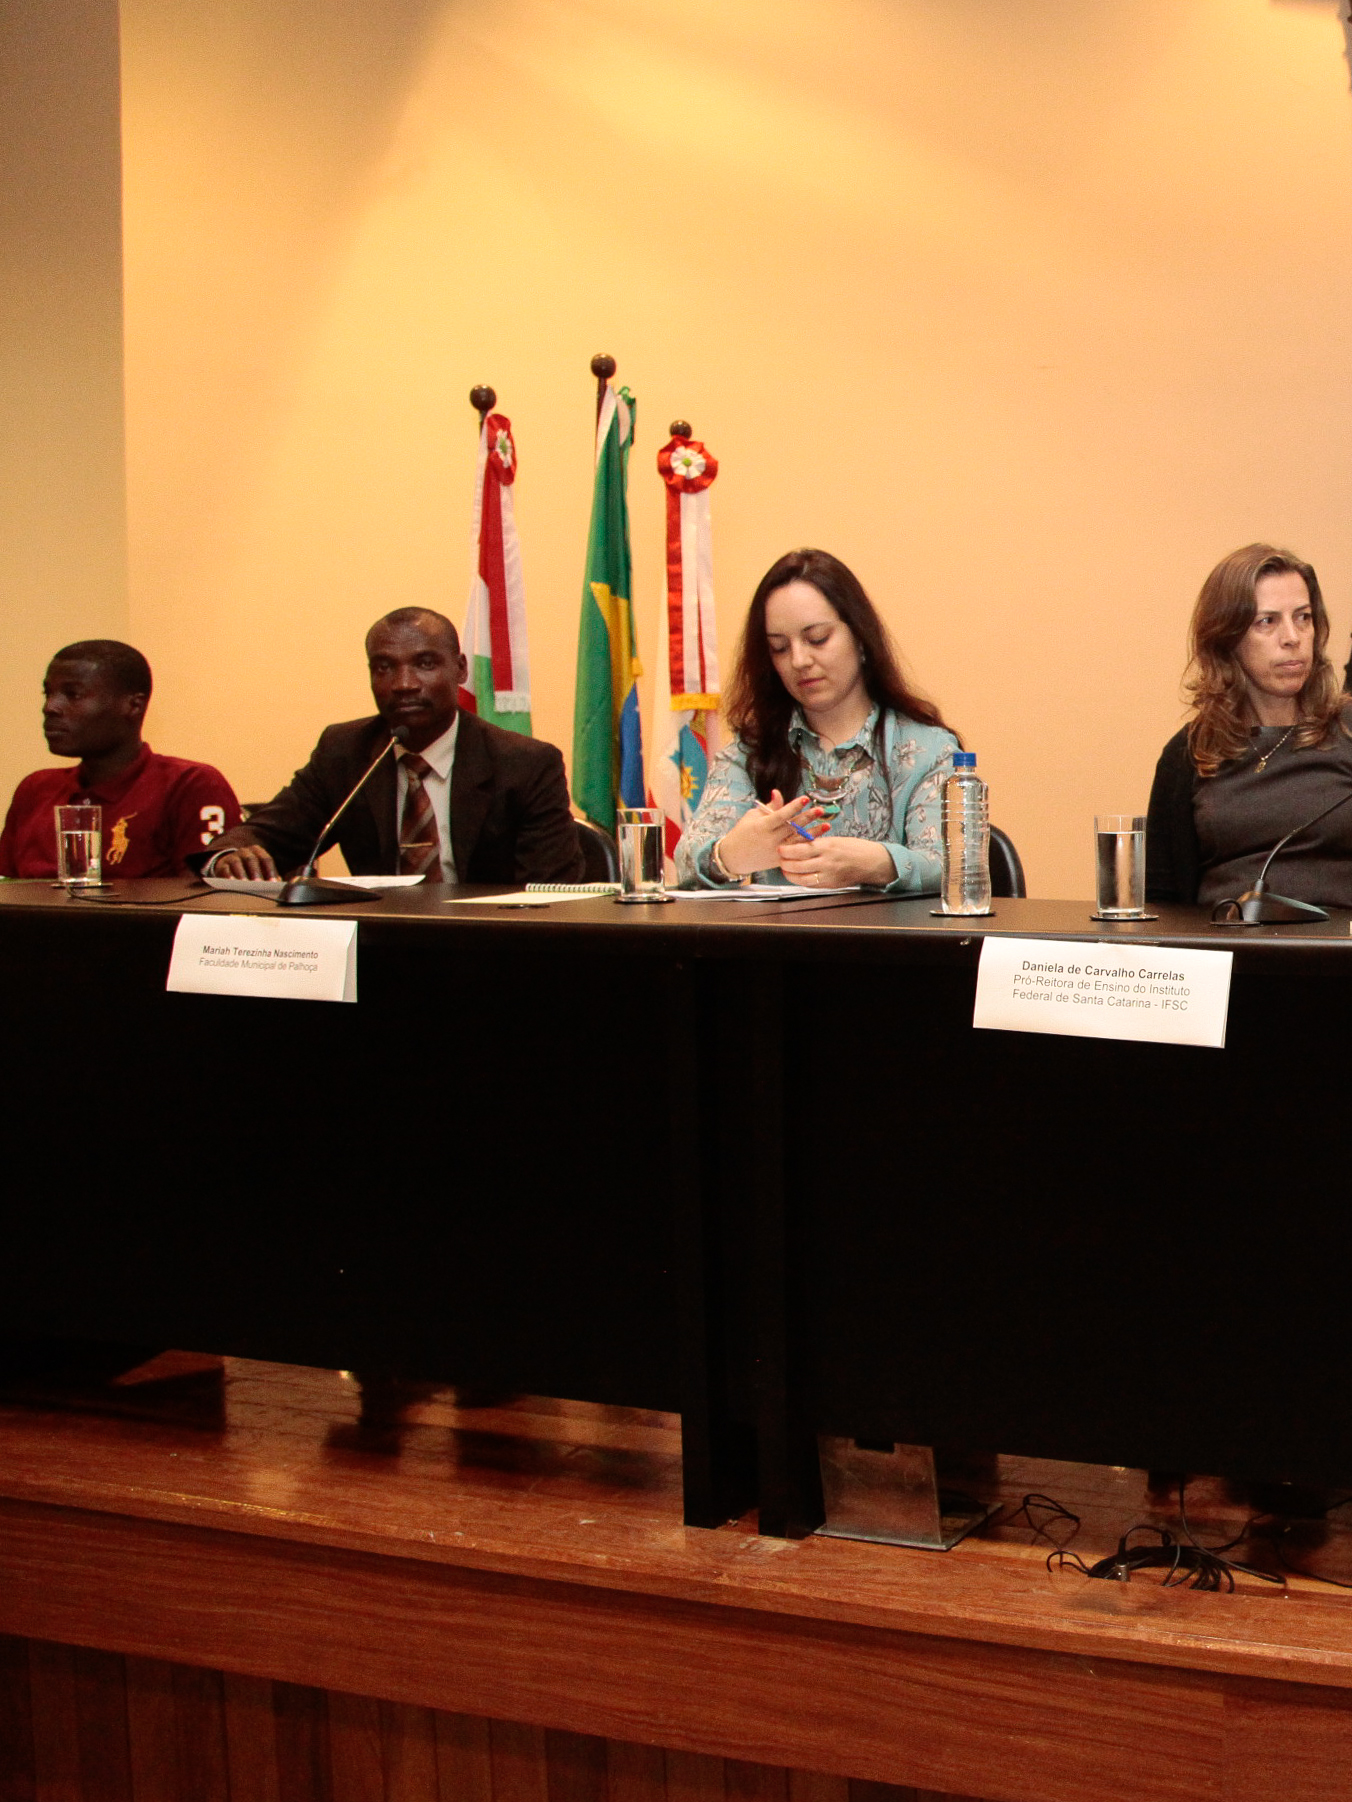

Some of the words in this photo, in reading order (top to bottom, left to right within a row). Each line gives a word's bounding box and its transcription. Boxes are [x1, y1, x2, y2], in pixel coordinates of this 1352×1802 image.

[200, 805, 225, 846] 3
[202, 945, 231, 956] Mariah
[233, 946, 272, 958] Terezinha
[273, 949, 319, 960] Nascimento
[199, 957, 240, 969] Faculdade
[241, 959, 276, 971] Municipal
[278, 961, 287, 970] de
[288, 961, 318, 973] Palhoça
[1021, 960, 1064, 974] Daniela
[1067, 963, 1082, 975] de
[1084, 965, 1135, 979] Carvalho
[1138, 968, 1186, 982] Carrelas
[1013, 974, 1074, 990] Pró-Reitora
[1077, 979, 1091, 991] de
[1094, 980, 1131, 994] Ensino
[1133, 982, 1146, 994] do
[1149, 984, 1191, 997] Instituto
[1012, 988, 1053, 1002] Federal
[1055, 990, 1069, 1003] de
[1072, 993, 1104, 1006] Santa
[1106, 996, 1152, 1009] Catarina
[1160, 999, 1189, 1011] IFSC
